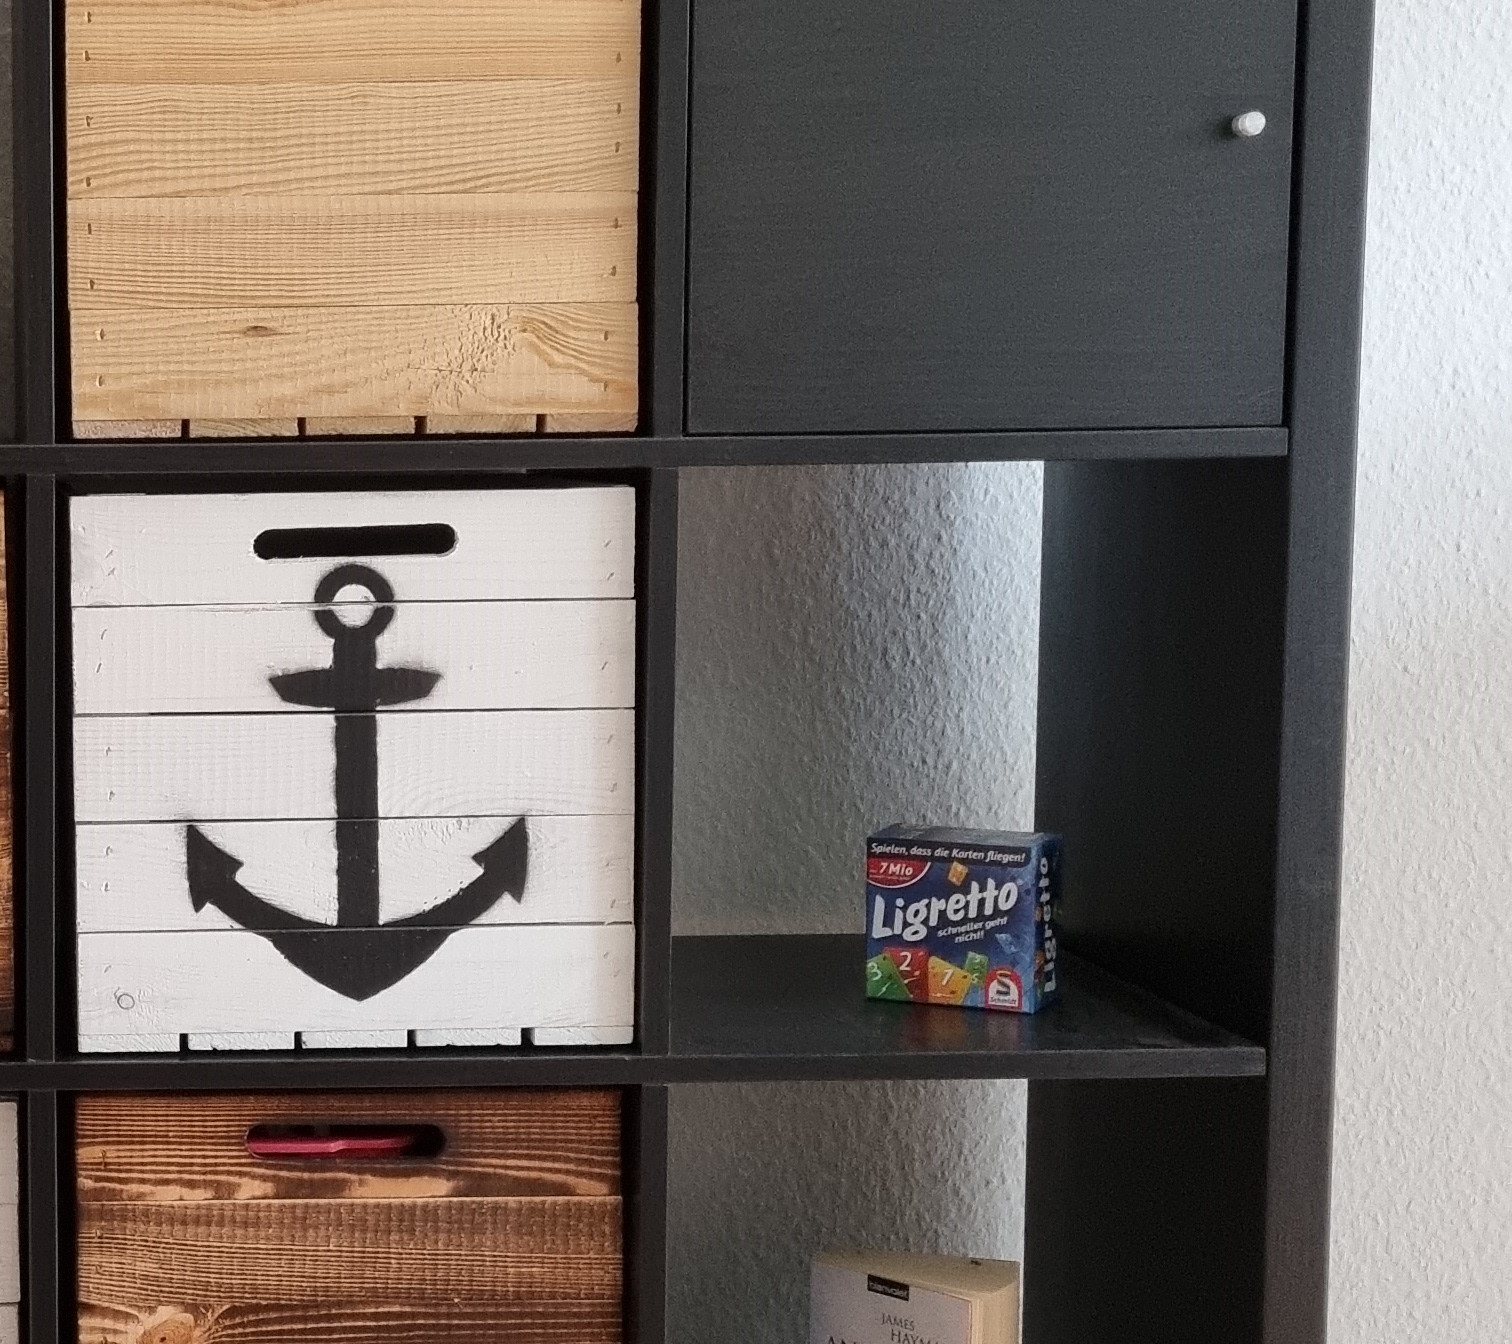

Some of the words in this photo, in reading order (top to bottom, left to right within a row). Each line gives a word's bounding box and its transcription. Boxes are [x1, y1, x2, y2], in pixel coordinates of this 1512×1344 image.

[871, 843, 908, 855] Spielen,
[910, 845, 932, 856] dass
[934, 846, 949, 858] die
[951, 848, 985, 860] Karten
[986, 850, 1026, 864] fliegen!
[888, 863, 914, 876] Mio
[872, 877, 1018, 942] Ligretto
[937, 920, 985, 937] schneller
[984, 916, 1008, 930] geht
[899, 951, 912, 971] 2
[867, 962, 882, 981] 3
[882, 1312, 915, 1331] JAMES
